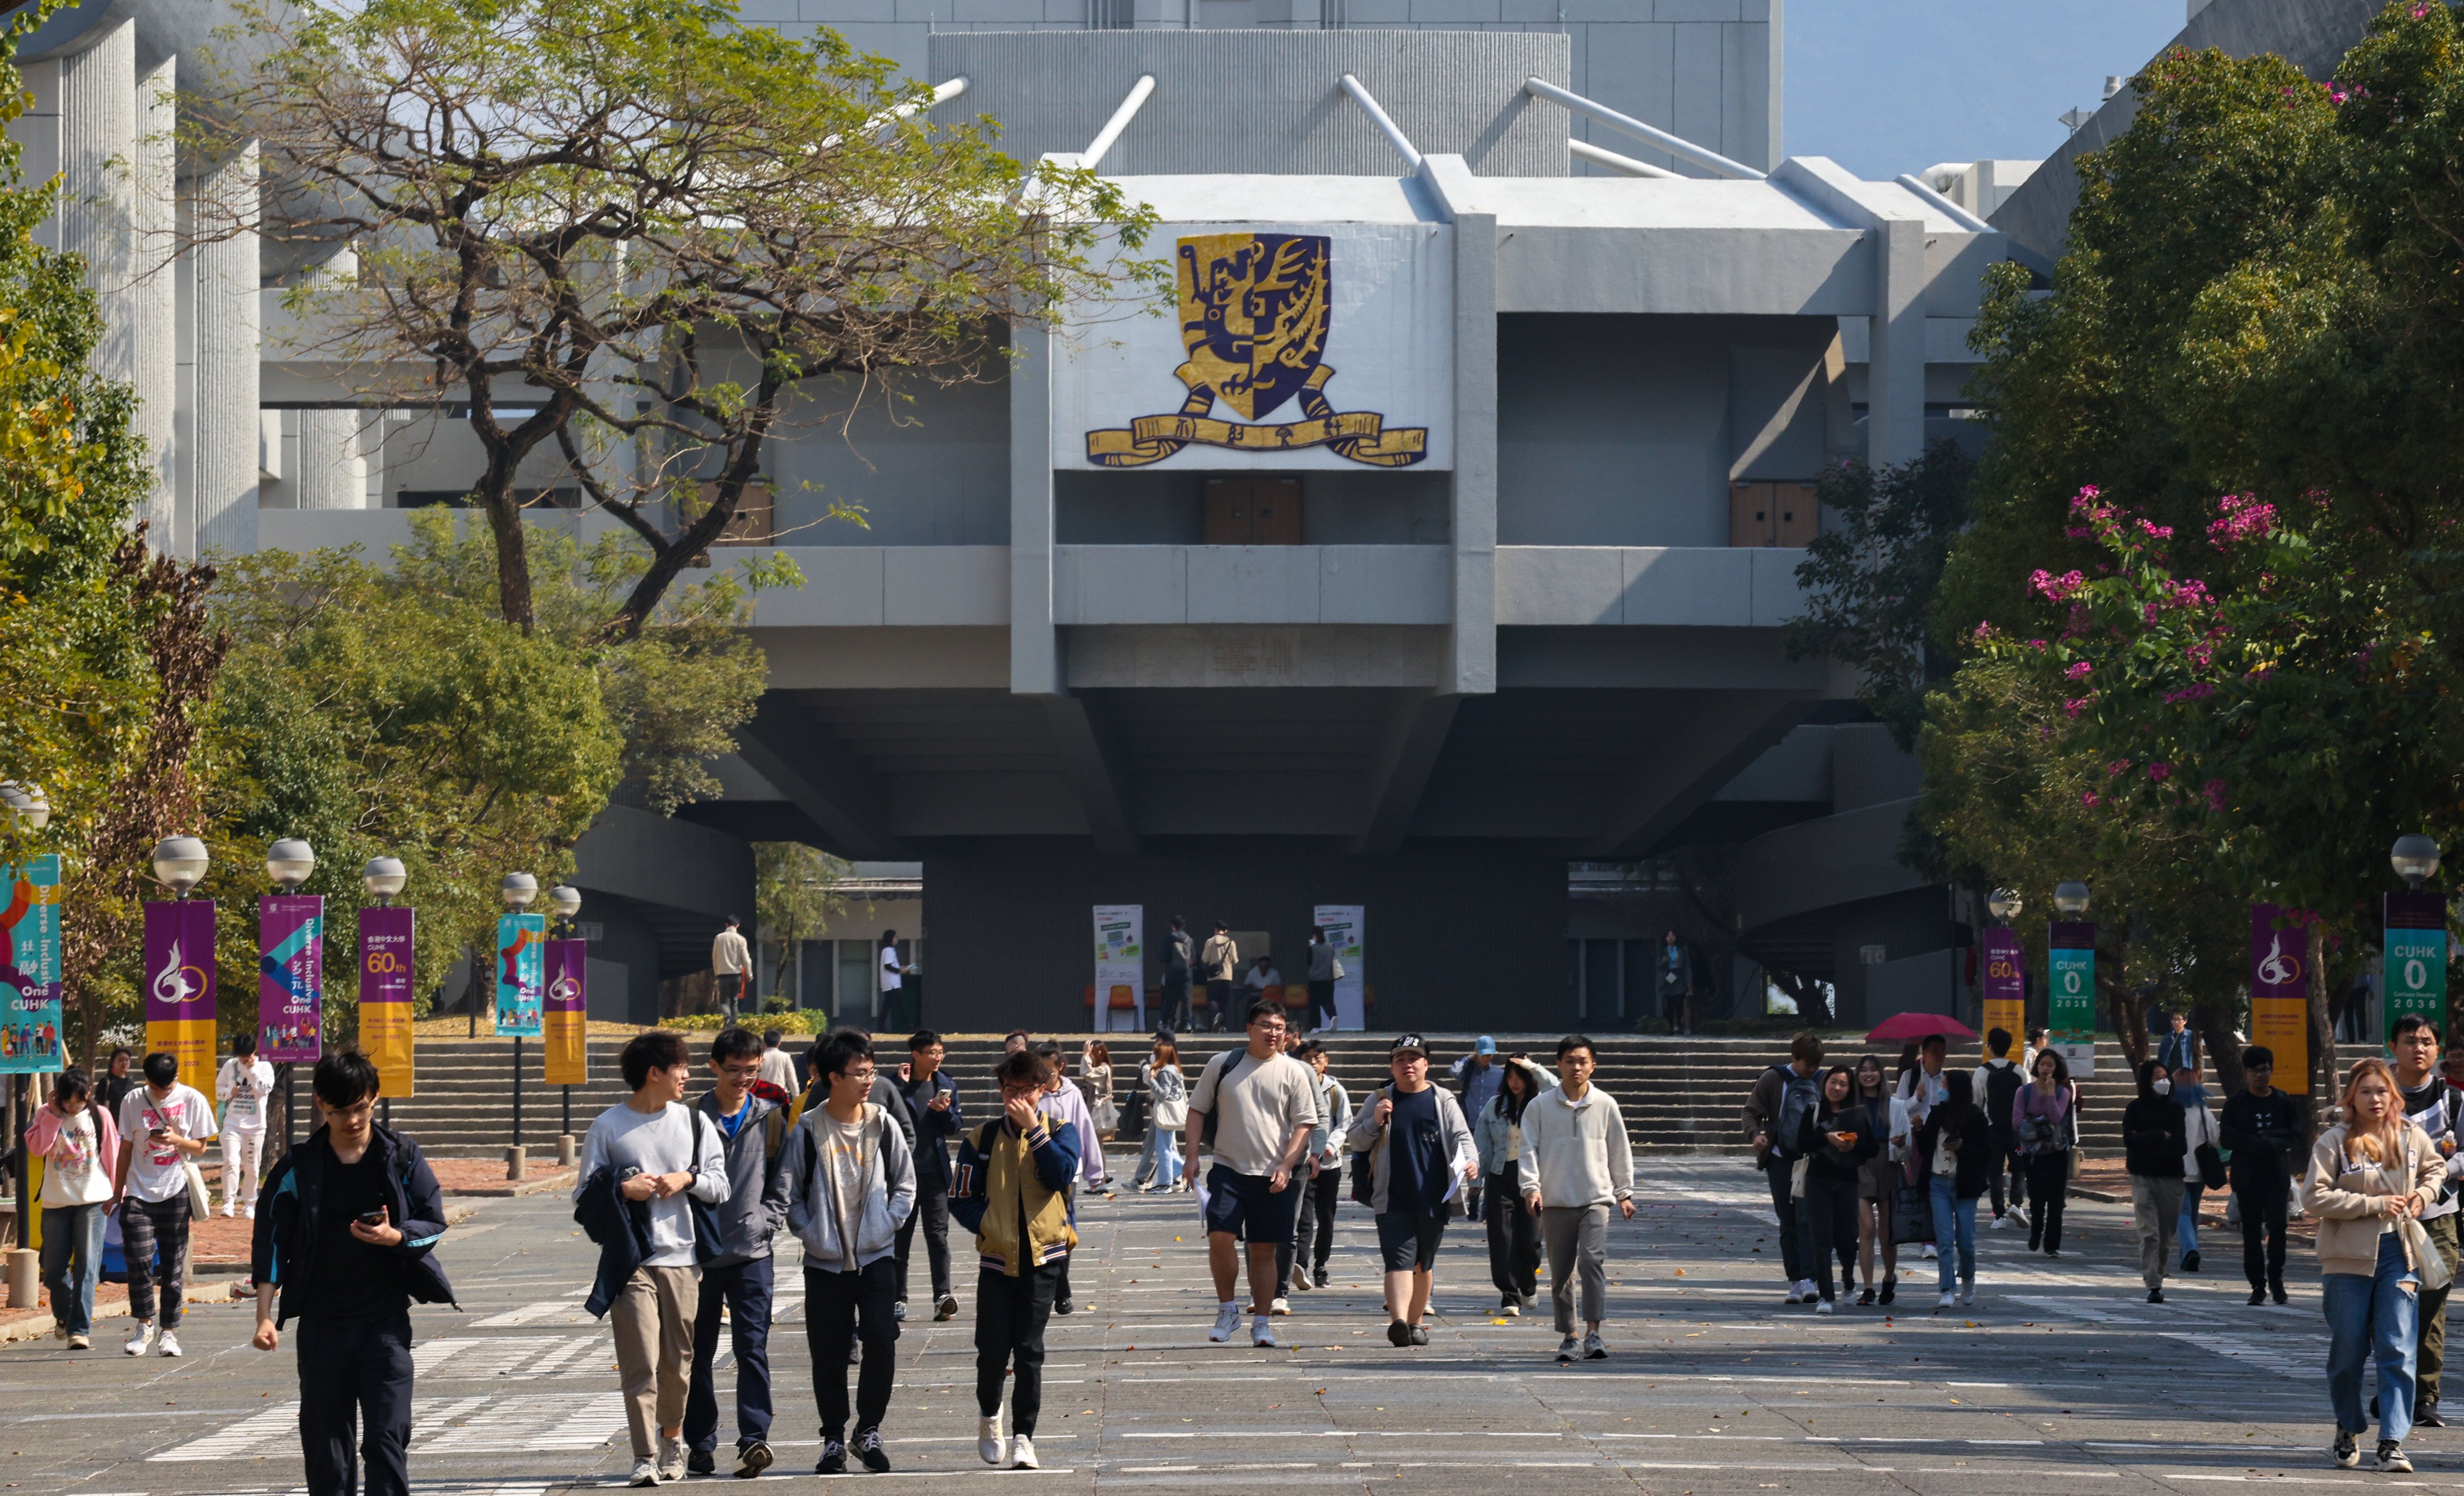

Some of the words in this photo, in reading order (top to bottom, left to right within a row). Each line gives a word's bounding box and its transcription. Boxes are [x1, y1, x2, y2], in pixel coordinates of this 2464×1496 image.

[2394, 946, 2436, 958] CUHK
[368, 952, 406, 973] 60th
[2056, 961, 2087, 970] CUHK
[2404, 959, 2427, 990] 0
[2064, 971, 2081, 994] 0
[22, 985, 49, 996] One
[11, 999, 49, 1011] CUHK
[291, 996, 311, 1004] One
[283, 1005, 311, 1014] CUHK
